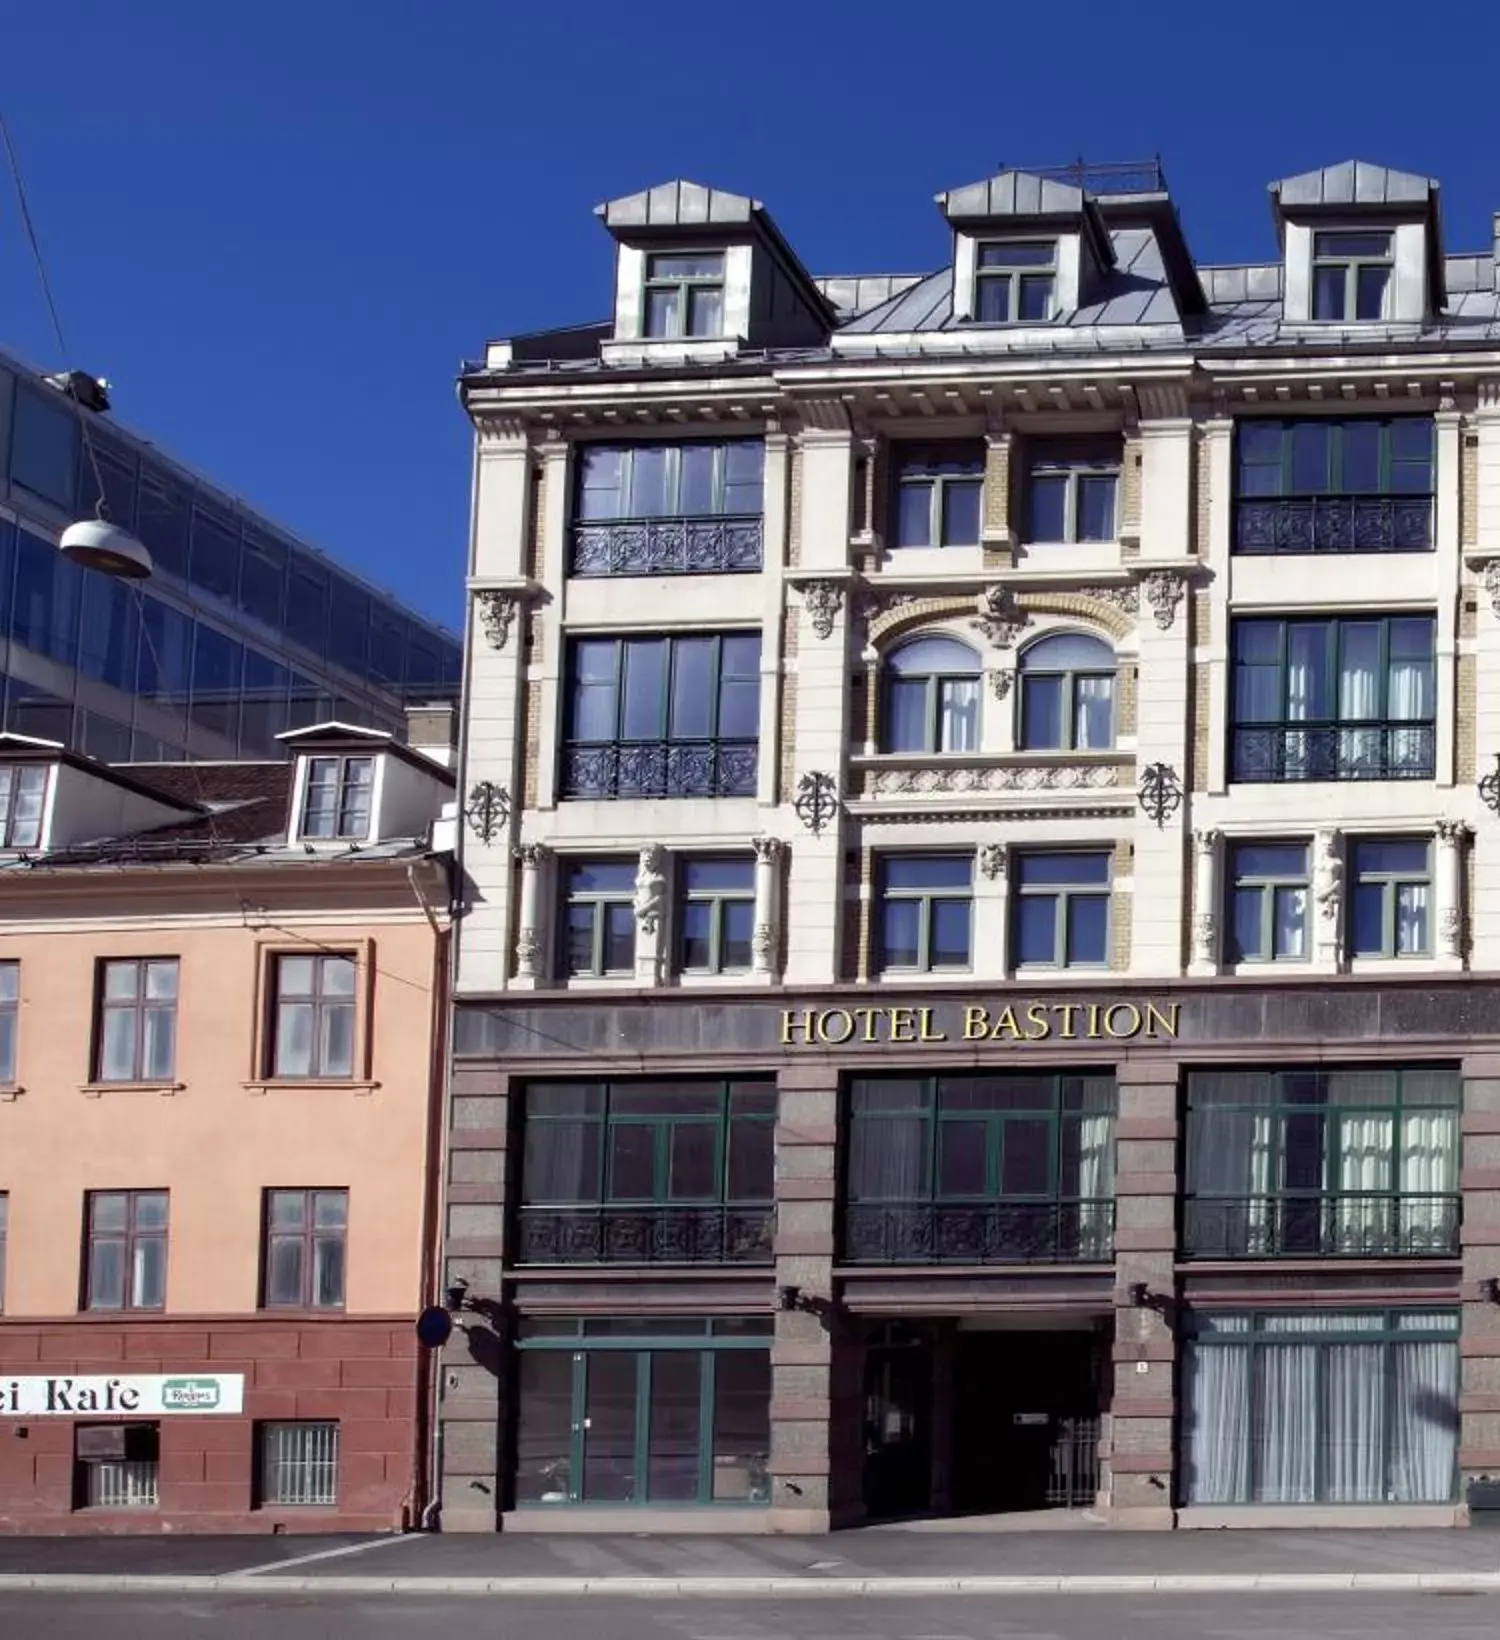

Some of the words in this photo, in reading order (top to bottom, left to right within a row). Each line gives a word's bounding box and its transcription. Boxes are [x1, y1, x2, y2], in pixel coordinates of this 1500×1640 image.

[779, 1007, 947, 1044] HOTEL
[961, 1002, 1182, 1042] BASTION
[46, 1380, 140, 1411] Kafe
